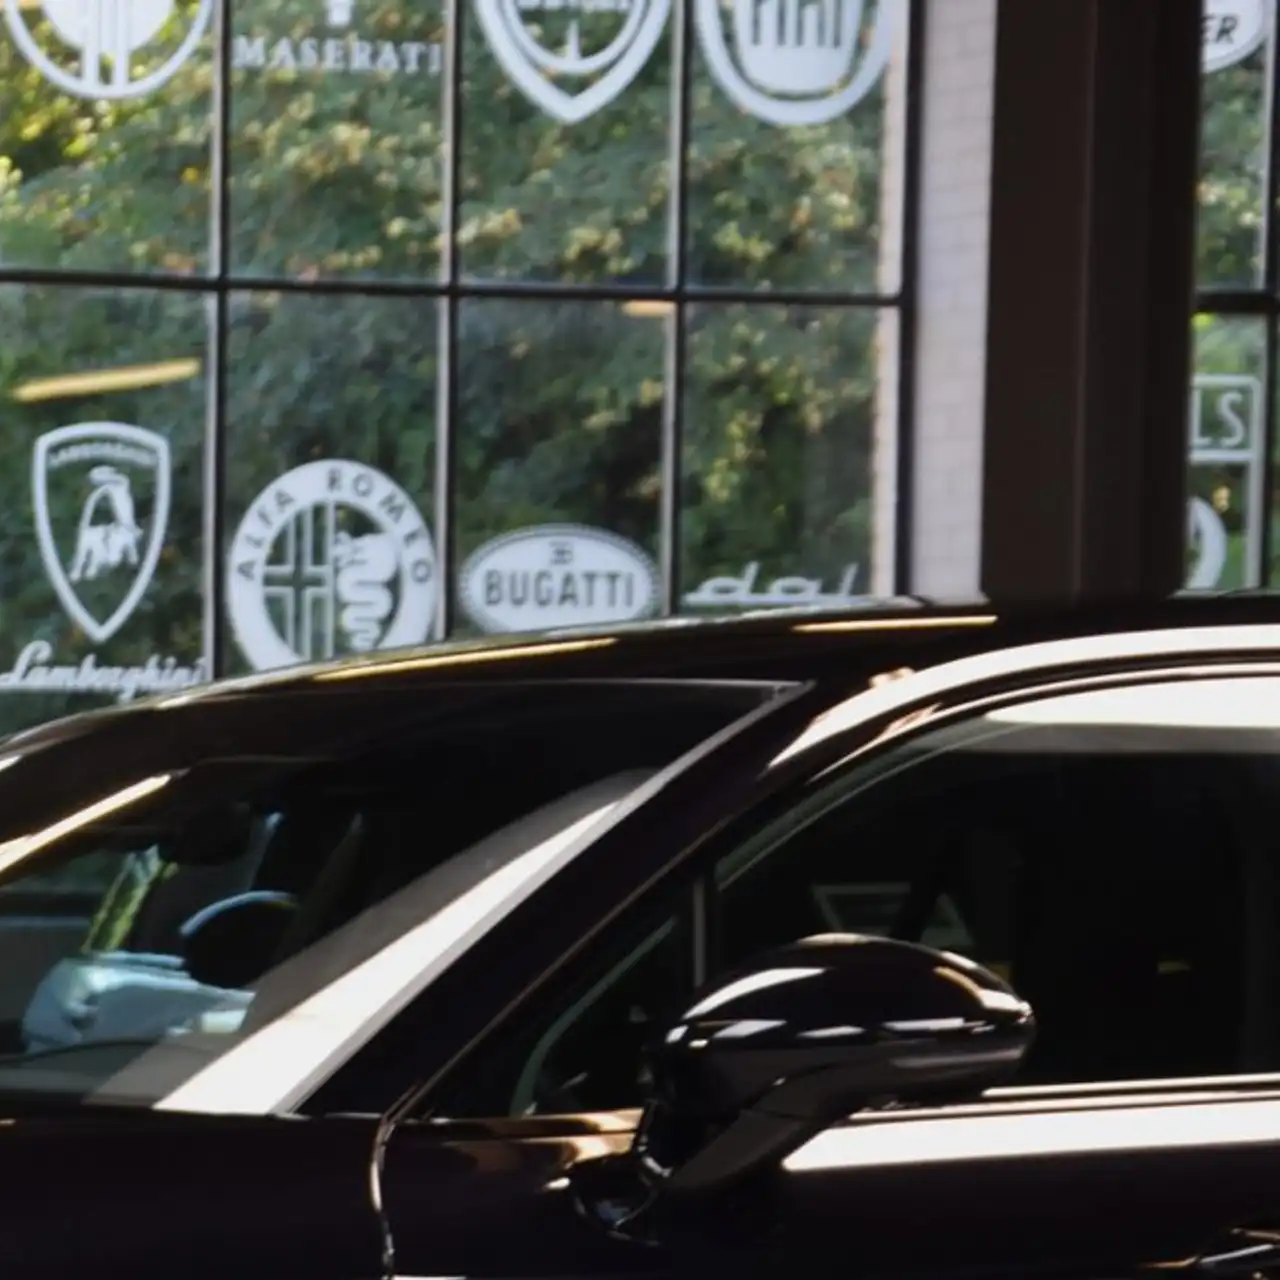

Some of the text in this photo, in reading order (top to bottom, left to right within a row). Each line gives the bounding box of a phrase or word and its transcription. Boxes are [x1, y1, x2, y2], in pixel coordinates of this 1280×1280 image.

[231, 34, 443, 77] MASERATI
[236, 466, 433, 585] ALFA ROMEO
[485, 569, 634, 609] BUGATTI
